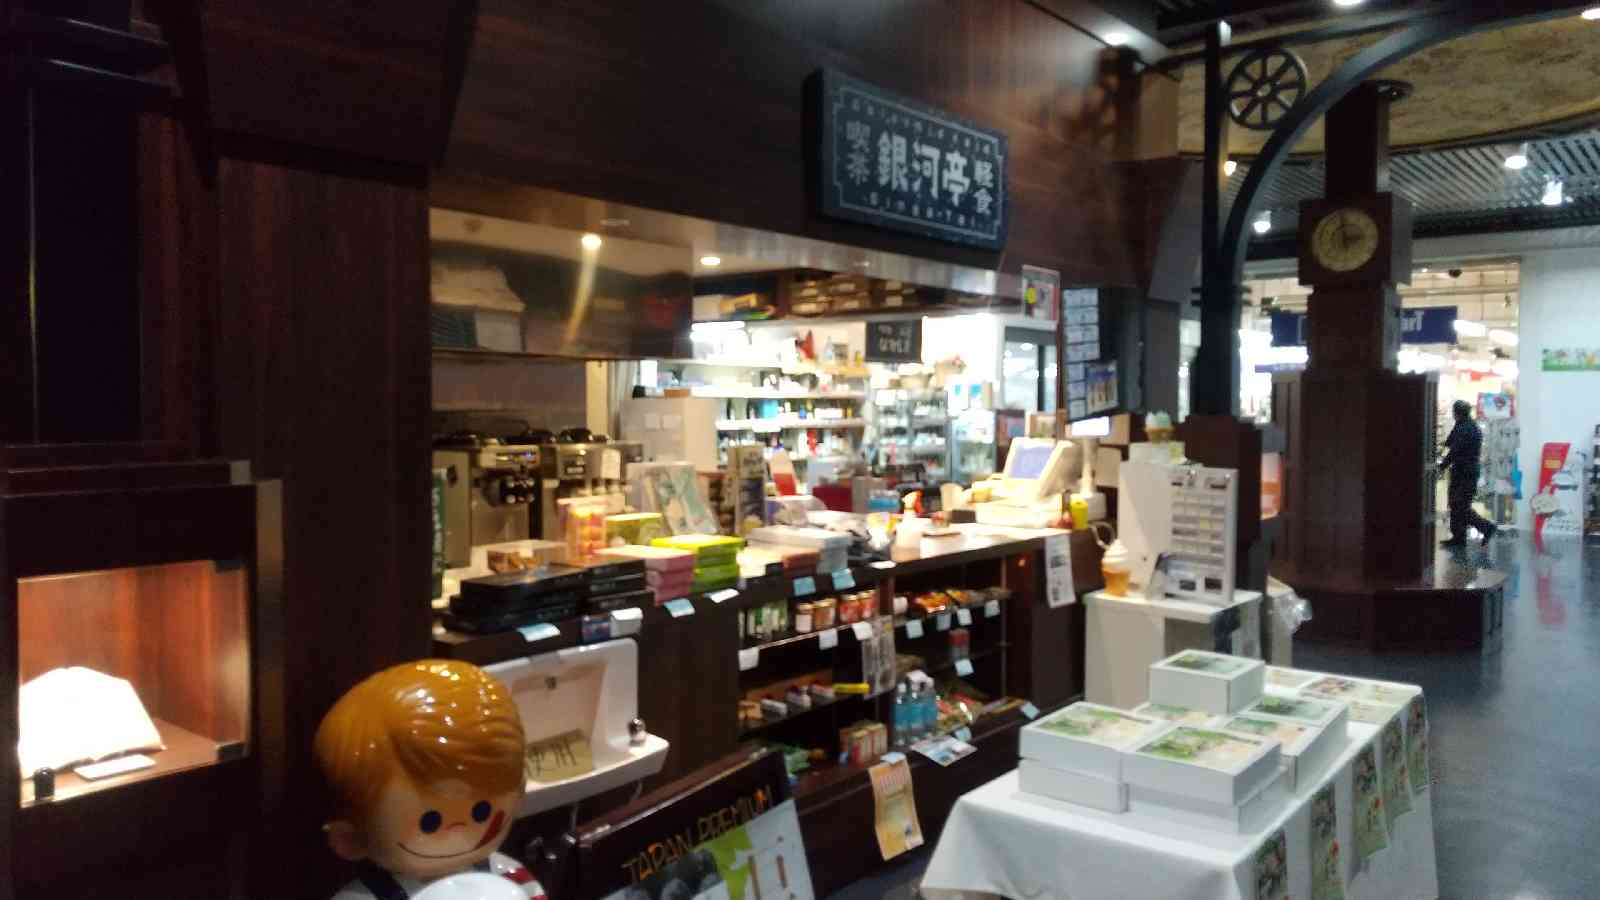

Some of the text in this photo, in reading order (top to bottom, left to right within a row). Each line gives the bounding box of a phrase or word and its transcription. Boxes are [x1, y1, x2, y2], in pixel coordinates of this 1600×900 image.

[846, 120, 871, 185] 喫茶
[877, 130, 971, 207] 銀河亭
